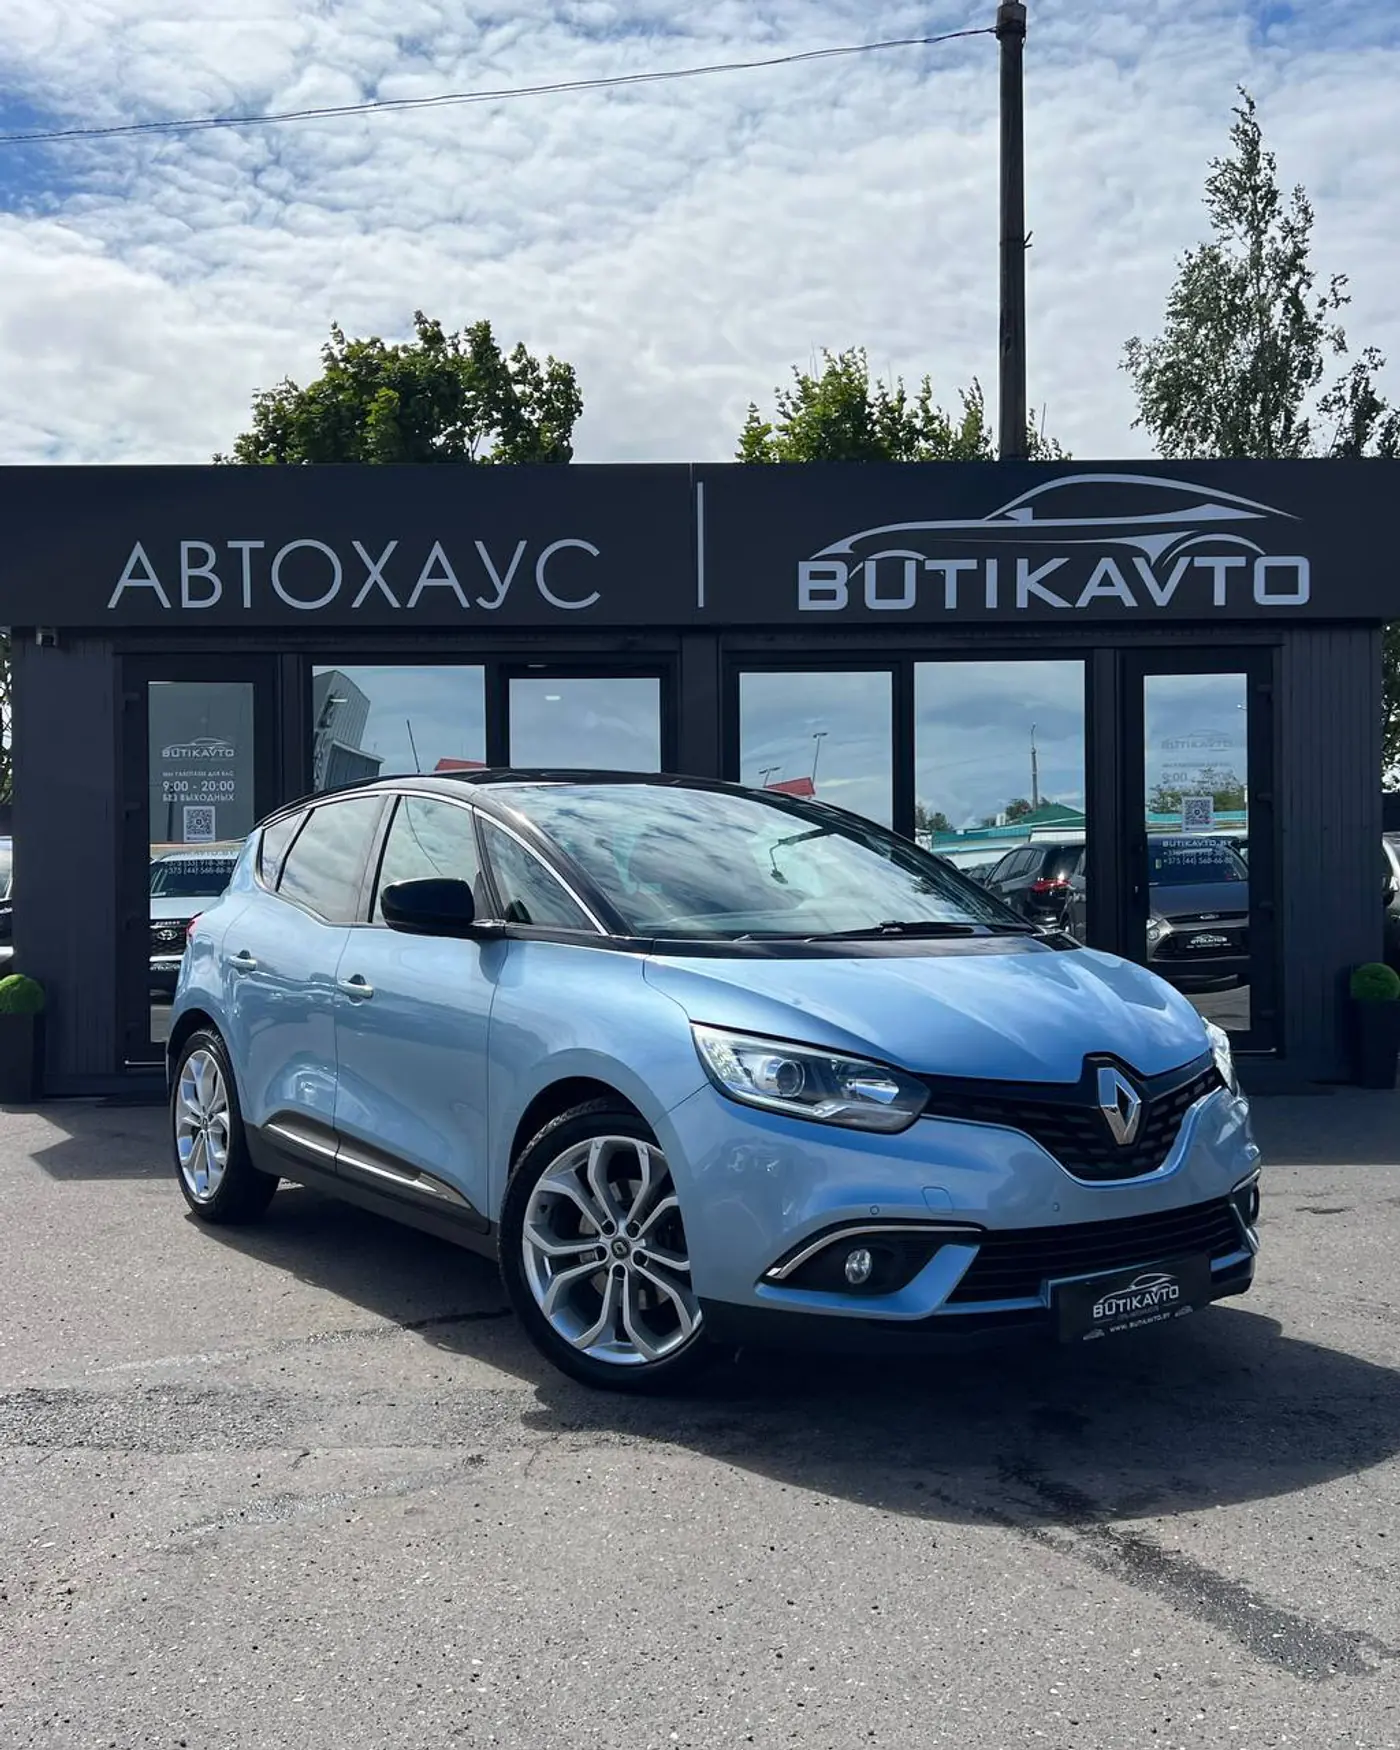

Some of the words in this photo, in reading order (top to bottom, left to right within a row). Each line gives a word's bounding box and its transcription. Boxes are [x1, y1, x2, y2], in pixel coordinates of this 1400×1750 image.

[107, 538, 601, 610] АВТОХАУС
[798, 555, 1310, 611] BUTIKAVTO
[162, 748, 234, 757] BUTIKAVTO
[162, 780, 189, 791] 9:00
[201, 780, 234, 791] 20:00
[1093, 1285, 1179, 1318] BUTIKAVTO
